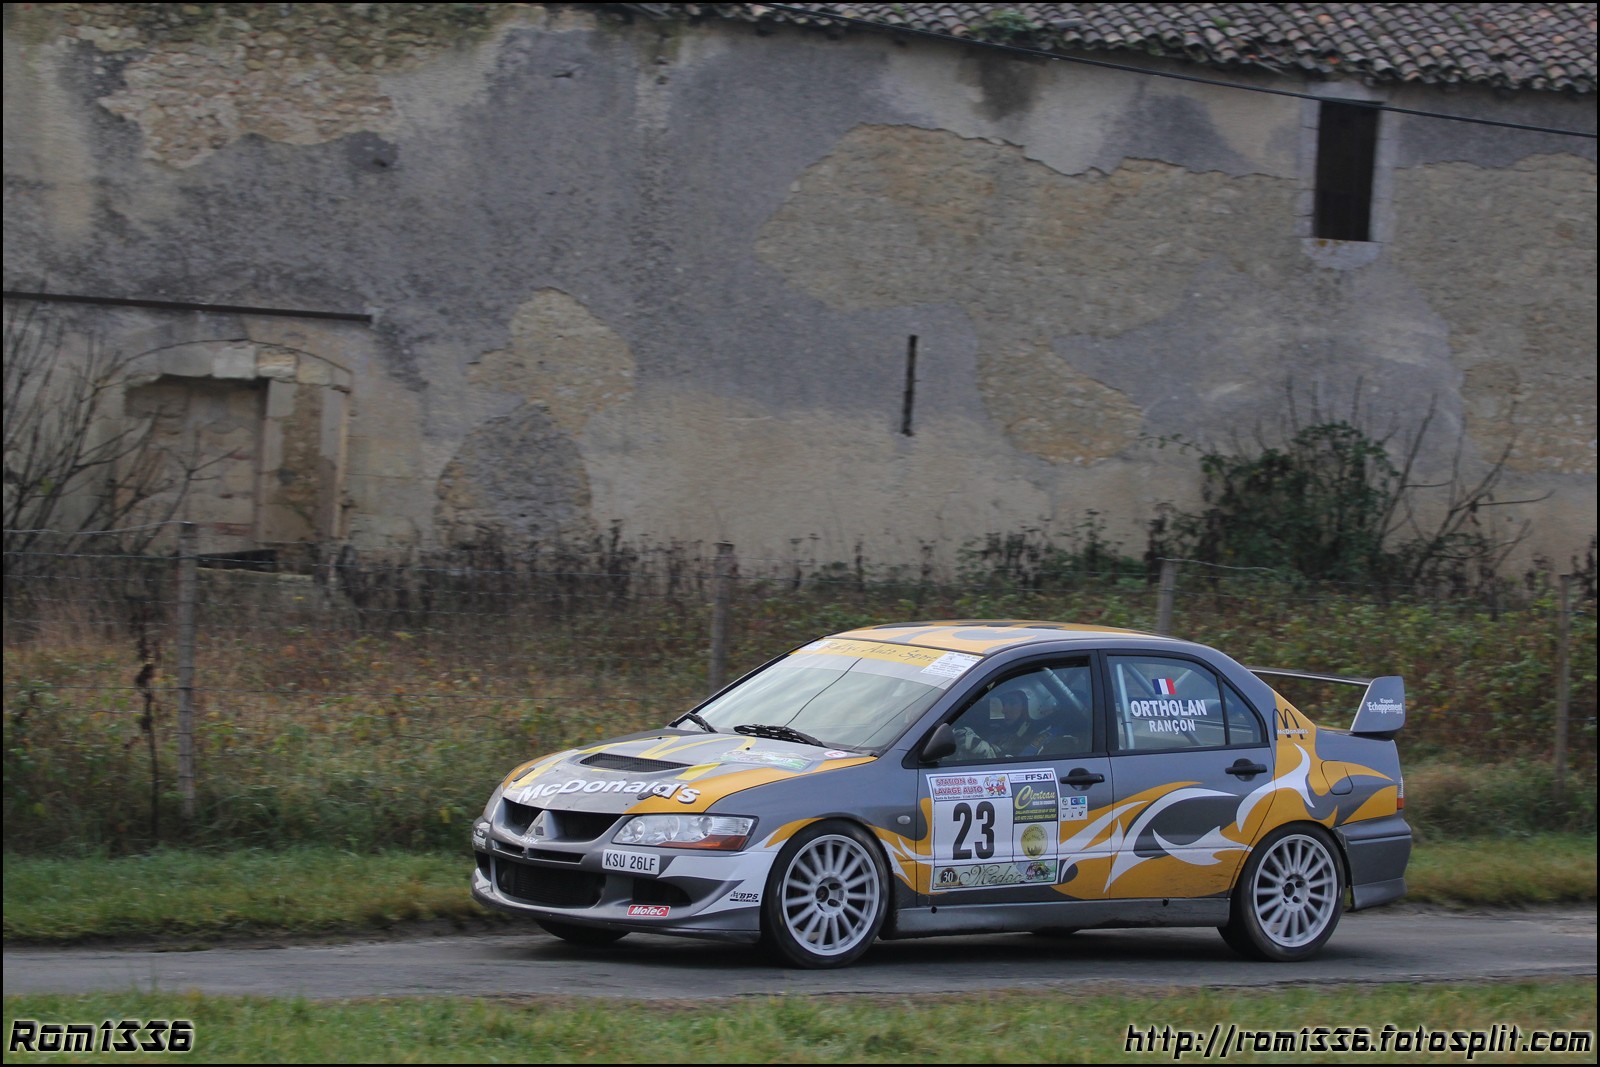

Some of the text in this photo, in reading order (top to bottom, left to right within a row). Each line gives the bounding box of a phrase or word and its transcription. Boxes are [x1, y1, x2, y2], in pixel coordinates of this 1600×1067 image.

[1130, 700, 1208, 717] ORTHOLAN
[1148, 719, 1196, 735] RANÇON
[936, 777, 978, 786] STATION de
[1025, 773, 1050, 781] FFSA
[515, 779, 701, 804] McDonald's
[934, 785, 984, 796] LAVAGE AUTO
[952, 801, 995, 860] 23
[605, 852, 656, 872] KSU 26LF
[943, 871, 954, 883] 30
[631, 906, 666, 915] MoTeC
